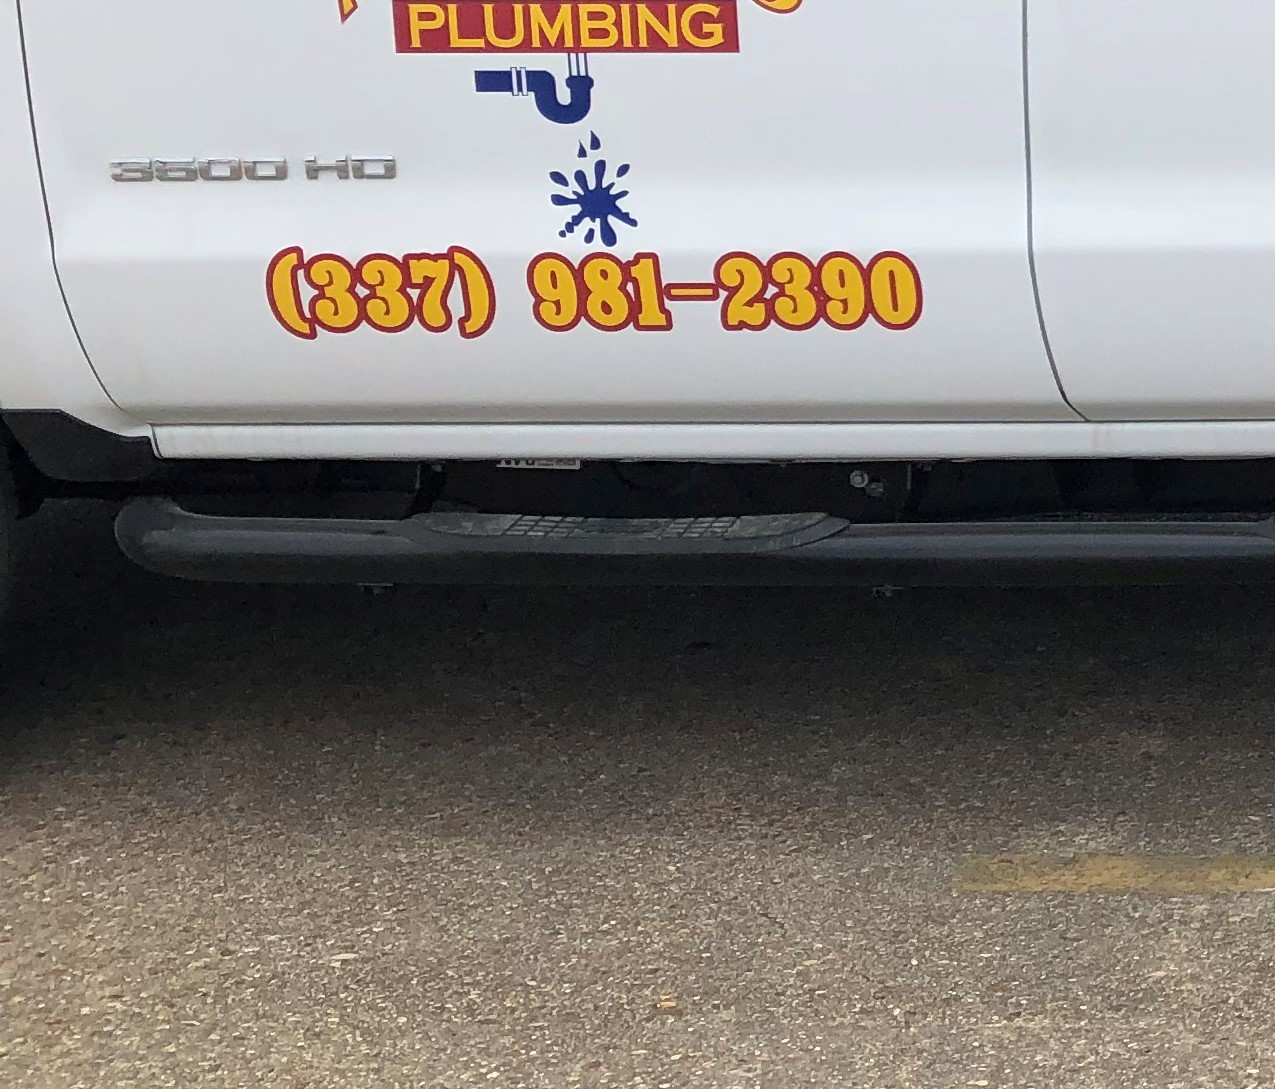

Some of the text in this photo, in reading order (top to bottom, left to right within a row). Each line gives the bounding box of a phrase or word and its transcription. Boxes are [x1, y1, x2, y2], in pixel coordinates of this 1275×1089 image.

[407, 1, 726, 49] PLUMBING
[109, 155, 397, 182] 3500 HD
[265, 245, 924, 340] (337) 981-2390
